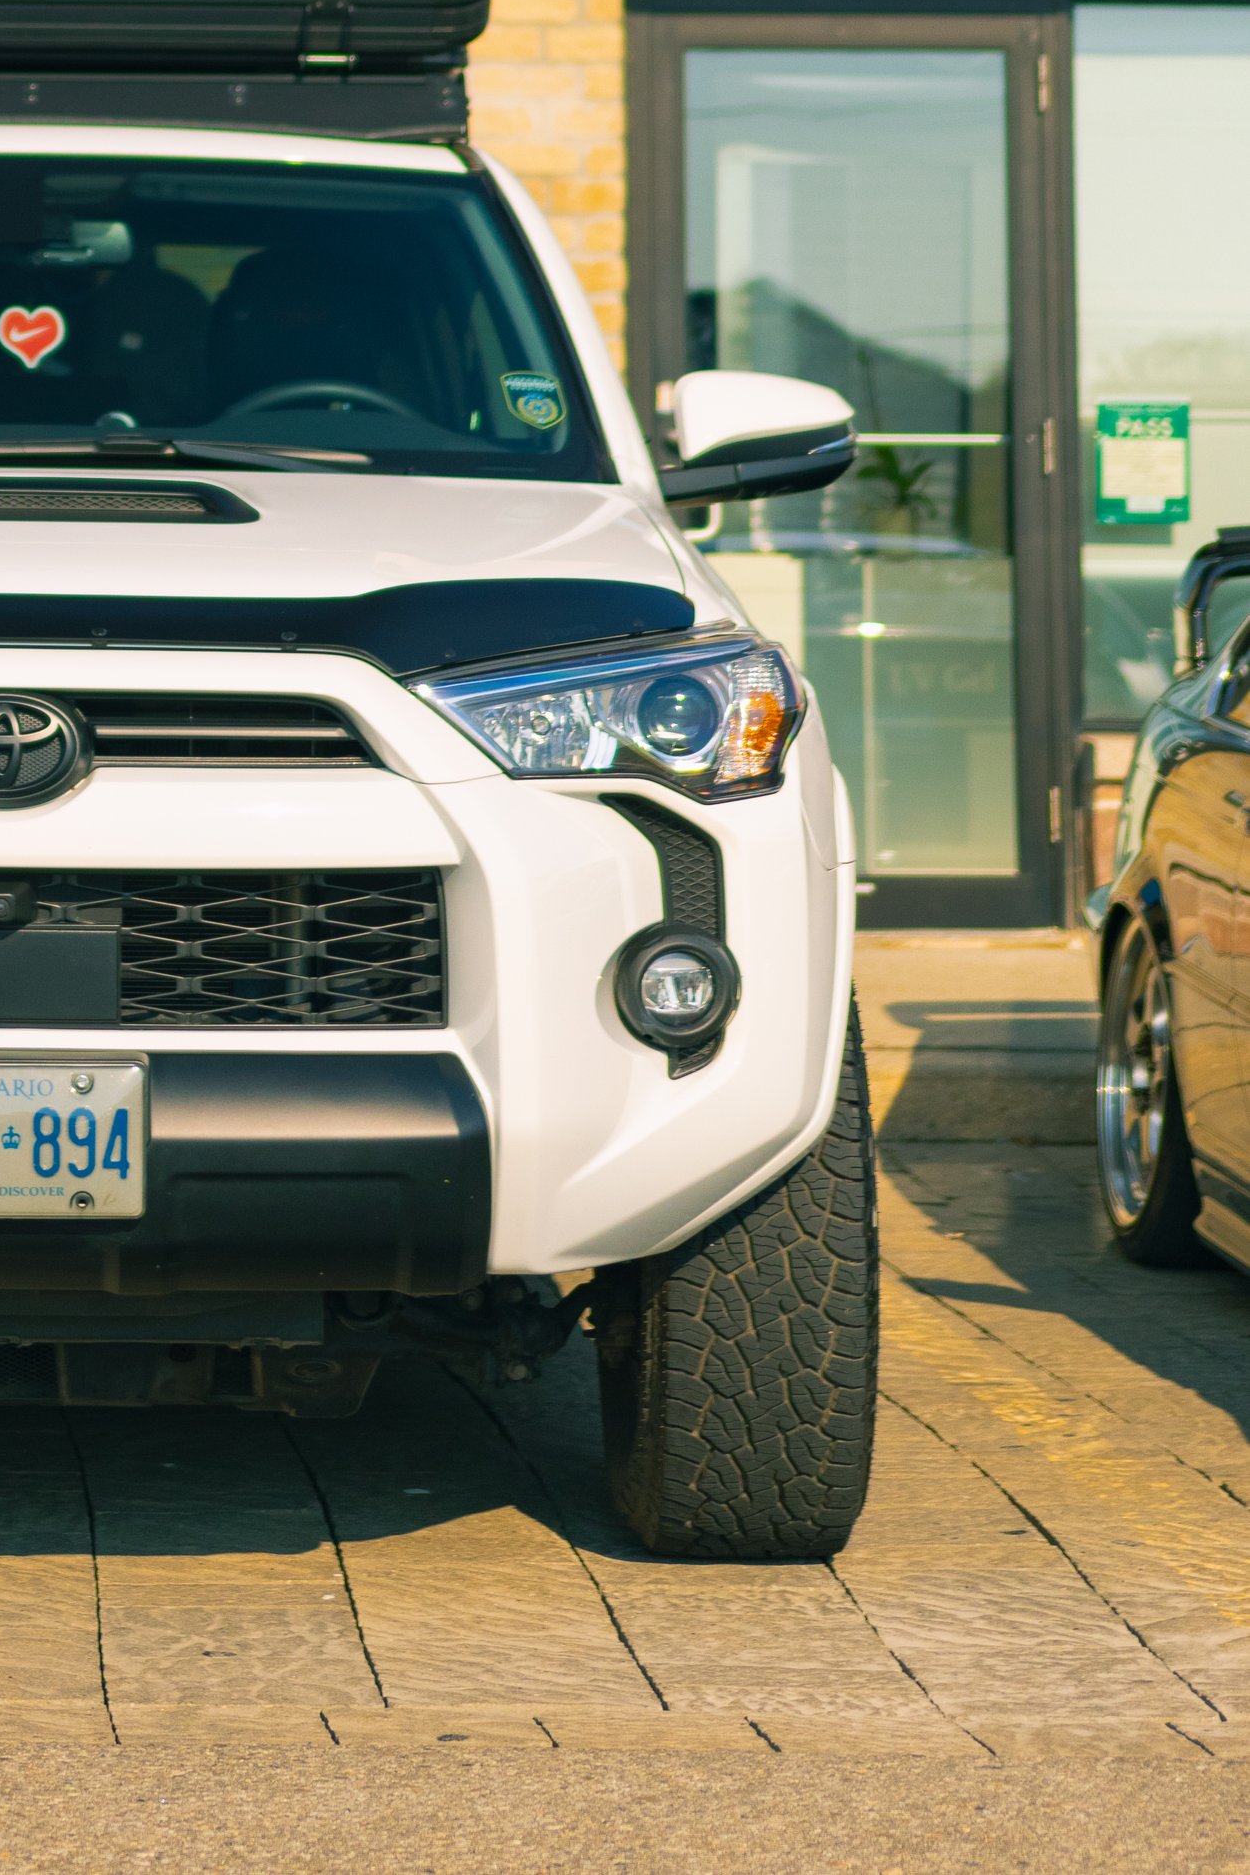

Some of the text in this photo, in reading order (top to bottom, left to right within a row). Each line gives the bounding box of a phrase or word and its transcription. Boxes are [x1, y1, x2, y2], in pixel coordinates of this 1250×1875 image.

[1115, 416, 1174, 437] PASS
[32, 1106, 131, 1180] 894
[0, 1186, 65, 1197] DISCOVER
